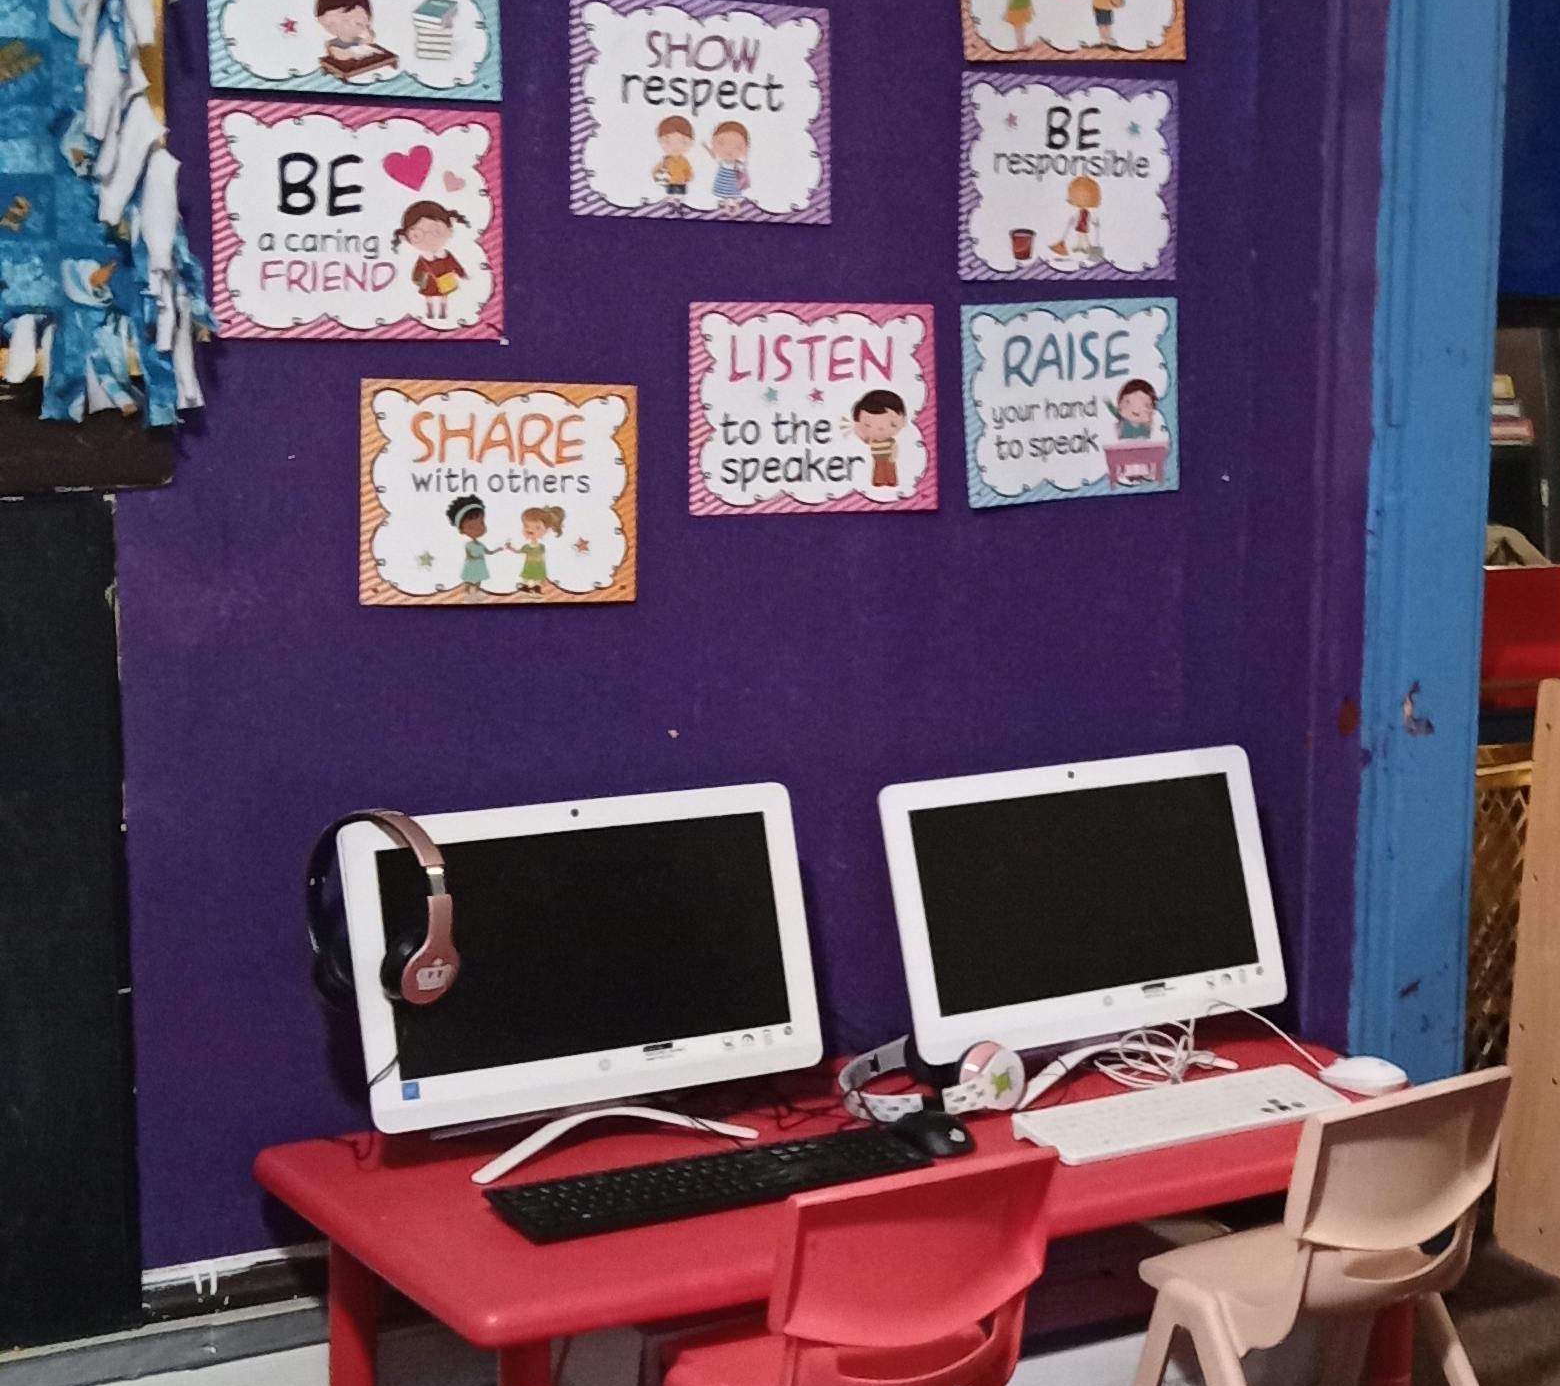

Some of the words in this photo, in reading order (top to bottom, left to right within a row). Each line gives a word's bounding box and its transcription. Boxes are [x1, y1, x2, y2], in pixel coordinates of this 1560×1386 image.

[646, 30, 760, 74] SHOW
[621, 73, 785, 116] respect
[1045, 105, 1101, 151] BE
[277, 151, 363, 216] BE
[993, 149, 1150, 182] responsible
[257, 232, 275, 253] a
[284, 229, 380, 260] caring
[259, 260, 397, 294] FRIEND
[728, 334, 894, 383] LISTEN
[1003, 330, 1130, 388] RAISE
[719, 413, 760, 446] to
[771, 411, 833, 446] the
[990, 405, 1040, 431] your
[1045, 396, 1098, 421] hand
[410, 411, 585, 468] SHARE
[994, 435, 1024, 461] to
[1029, 428, 1100, 463] speak
[411, 468, 478, 493] with
[487, 469, 592, 494] others
[720, 448, 865, 492] speaker
